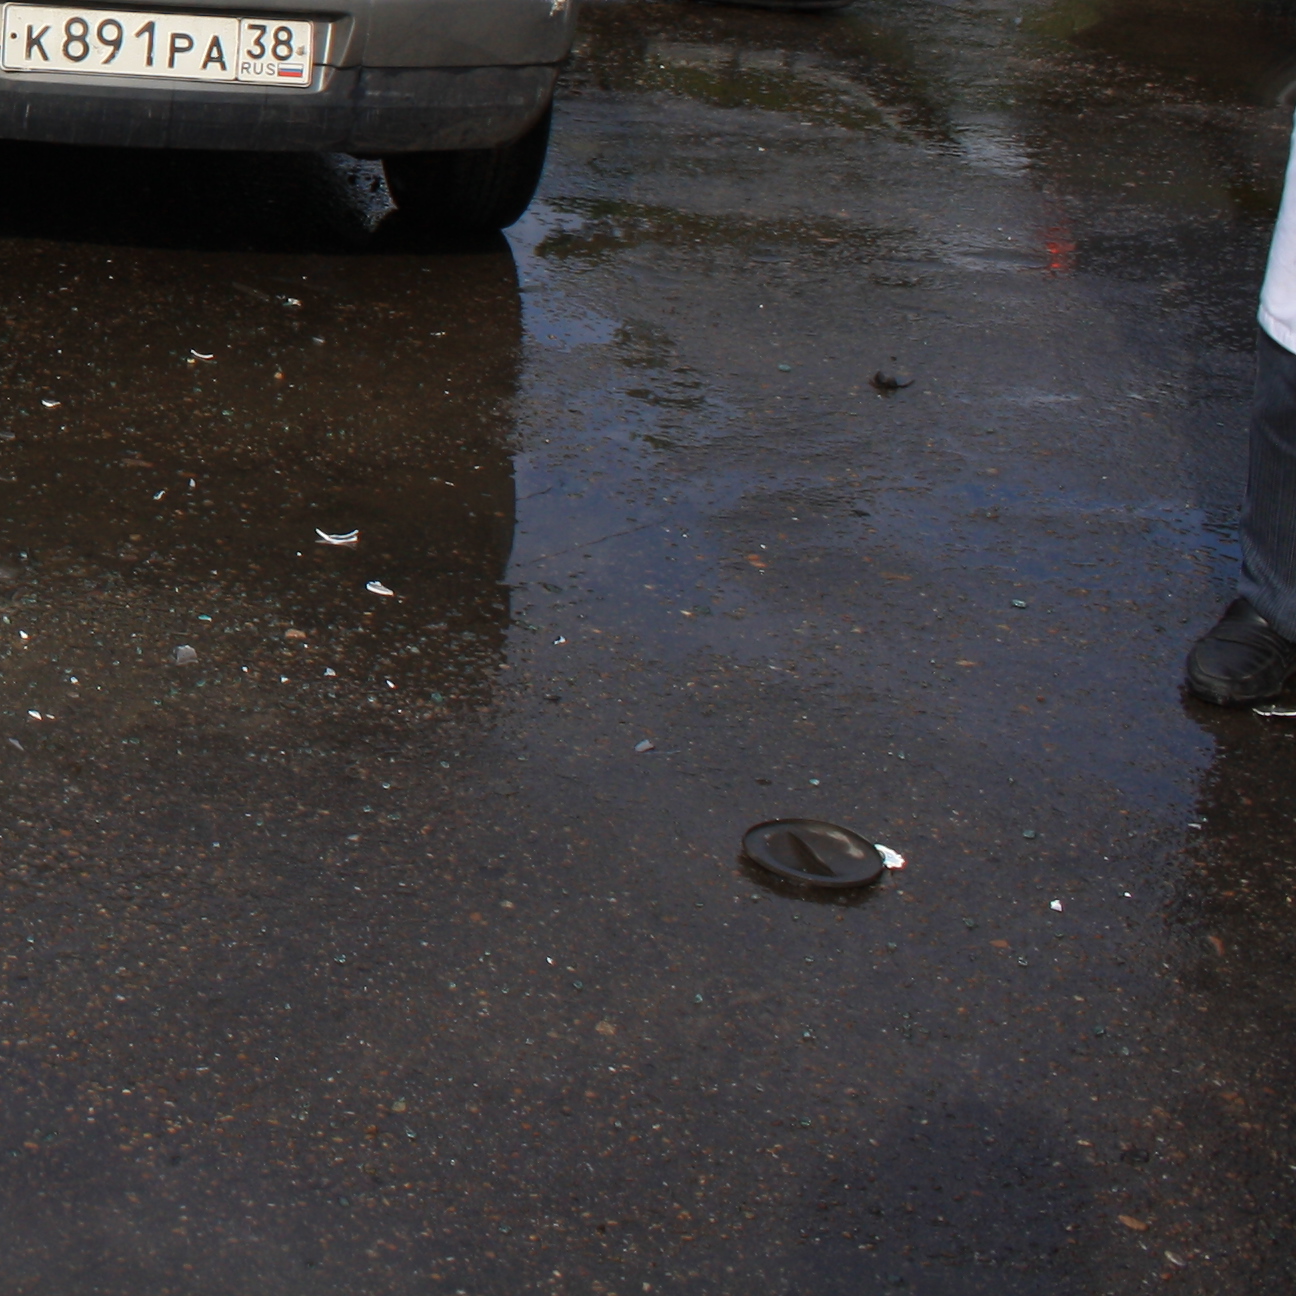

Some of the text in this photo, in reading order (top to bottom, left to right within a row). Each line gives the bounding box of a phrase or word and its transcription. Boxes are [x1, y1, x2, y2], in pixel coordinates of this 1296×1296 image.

[25, 16, 294, 71] К891РА 38
[241, 62, 276, 76] RUS
